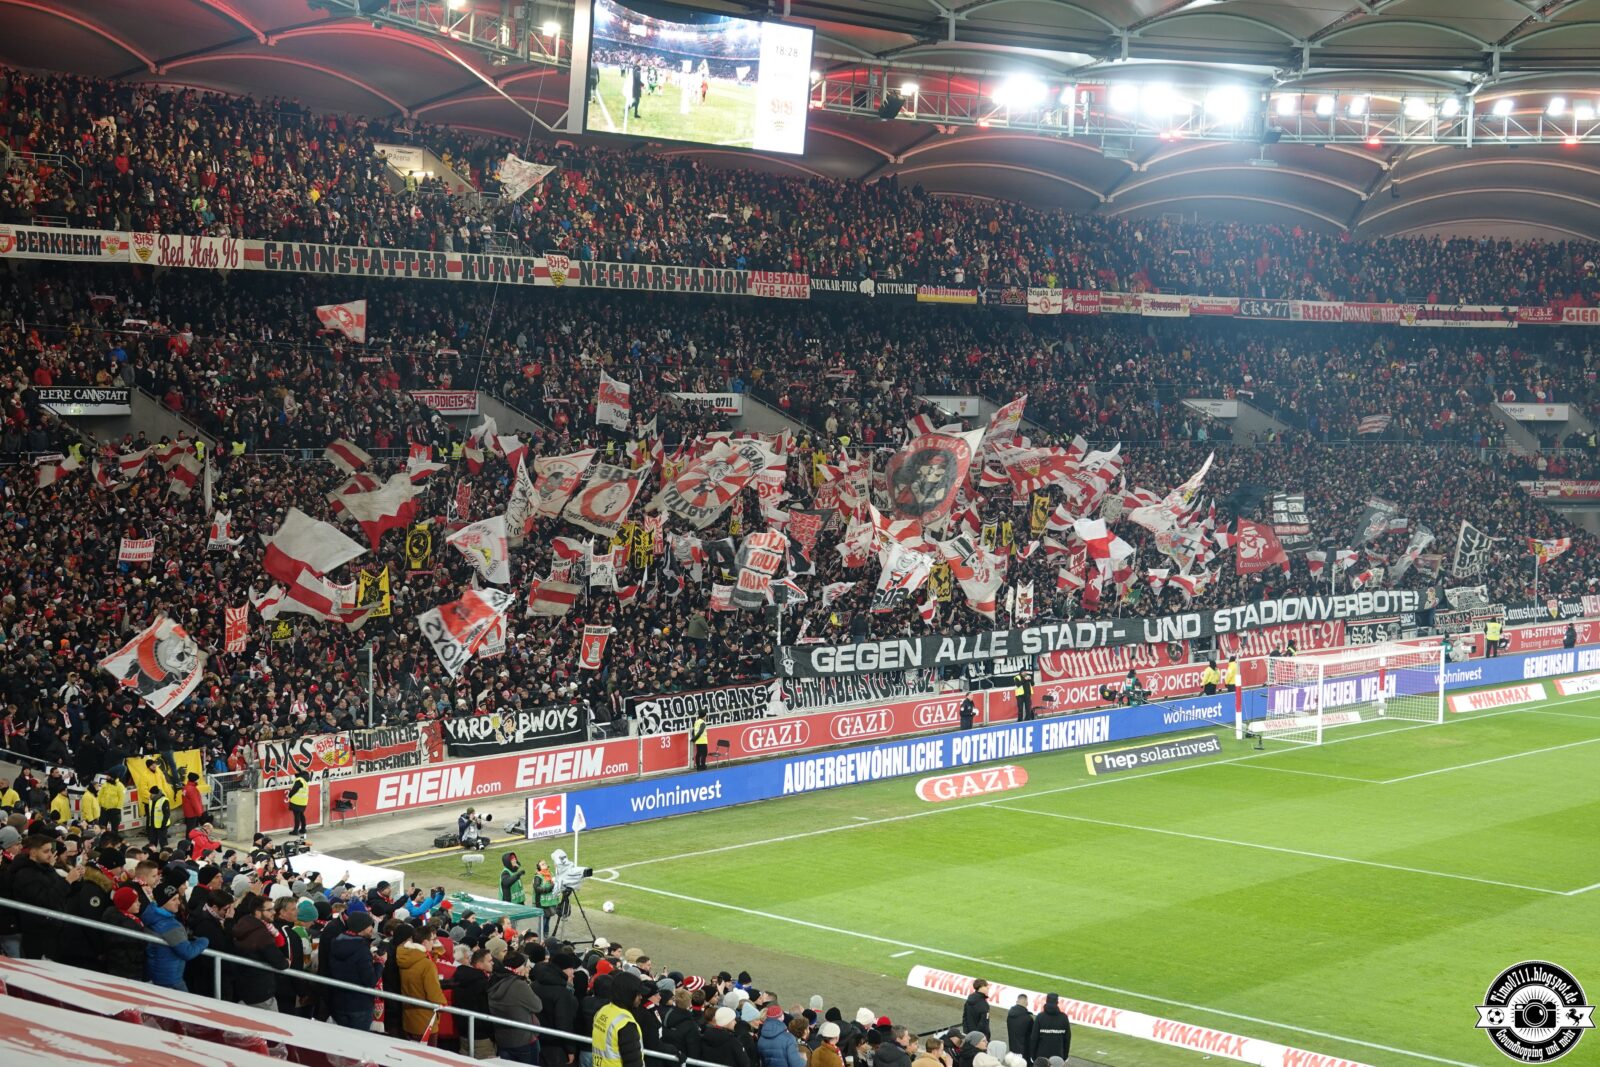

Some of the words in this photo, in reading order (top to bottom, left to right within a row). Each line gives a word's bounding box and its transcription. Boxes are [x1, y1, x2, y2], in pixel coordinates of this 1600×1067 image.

[15, 231, 102, 256] BERKHEIM
[158, 234, 185, 266] Red
[188, 237, 219, 268] Hots
[222, 238, 238, 268] 96
[263, 243, 448, 279] CANNSTATTER
[579, 262, 749, 294] NECKARSTADION
[753, 271, 810, 285] ALBSTADT
[811, 278, 858, 293] NECKAR-FILS
[877, 282, 918, 295] STUTTGART
[755, 284, 808, 298] VFB-FANS
[1302, 304, 1343, 321] RHÖN
[1344, 306, 1371, 322] DONAU
[1380, 307, 1400, 323] RIES
[73, 389, 128, 402] CANNSTATT
[715, 397, 733, 408] 0711
[1557, 601, 1584, 618] Jungs
[811, 638, 922, 673] GEGEN
[934, 630, 1009, 663] ALLE
[1021, 620, 1126, 656] STADT-
[1144, 613, 1200, 643] UND
[1213, 591, 1420, 633] STADIONVERBOTE!
[1520, 625, 1568, 639] VfB-STIFTUNG
[1523, 652, 1575, 680] GEMEINSAM
[657, 684, 768, 719] HOOLIGANS
[1002, 691, 1011, 702] 34
[1274, 688, 1299, 714] MUT
[1323, 680, 1357, 709] NEUEN
[1468, 686, 1533, 710] WINAMAX
[518, 706, 578, 734] BWOYS
[1163, 702, 1223, 725] wohninvest
[660, 736, 671, 748] 33
[952, 724, 1034, 766] POTENTIALE
[1041, 715, 1110, 750] ERKENNEN
[1104, 751, 1138, 770] hep
[1140, 737, 1220, 763] solarinvest
[515, 747, 629, 789] EHEIM.com
[376, 765, 502, 810] EHEIM.com
[631, 779, 722, 812] wohninvest
[532, 828, 563, 839] BUNDESLIGA
[1151, 1018, 1250, 1058] WINAMAX
